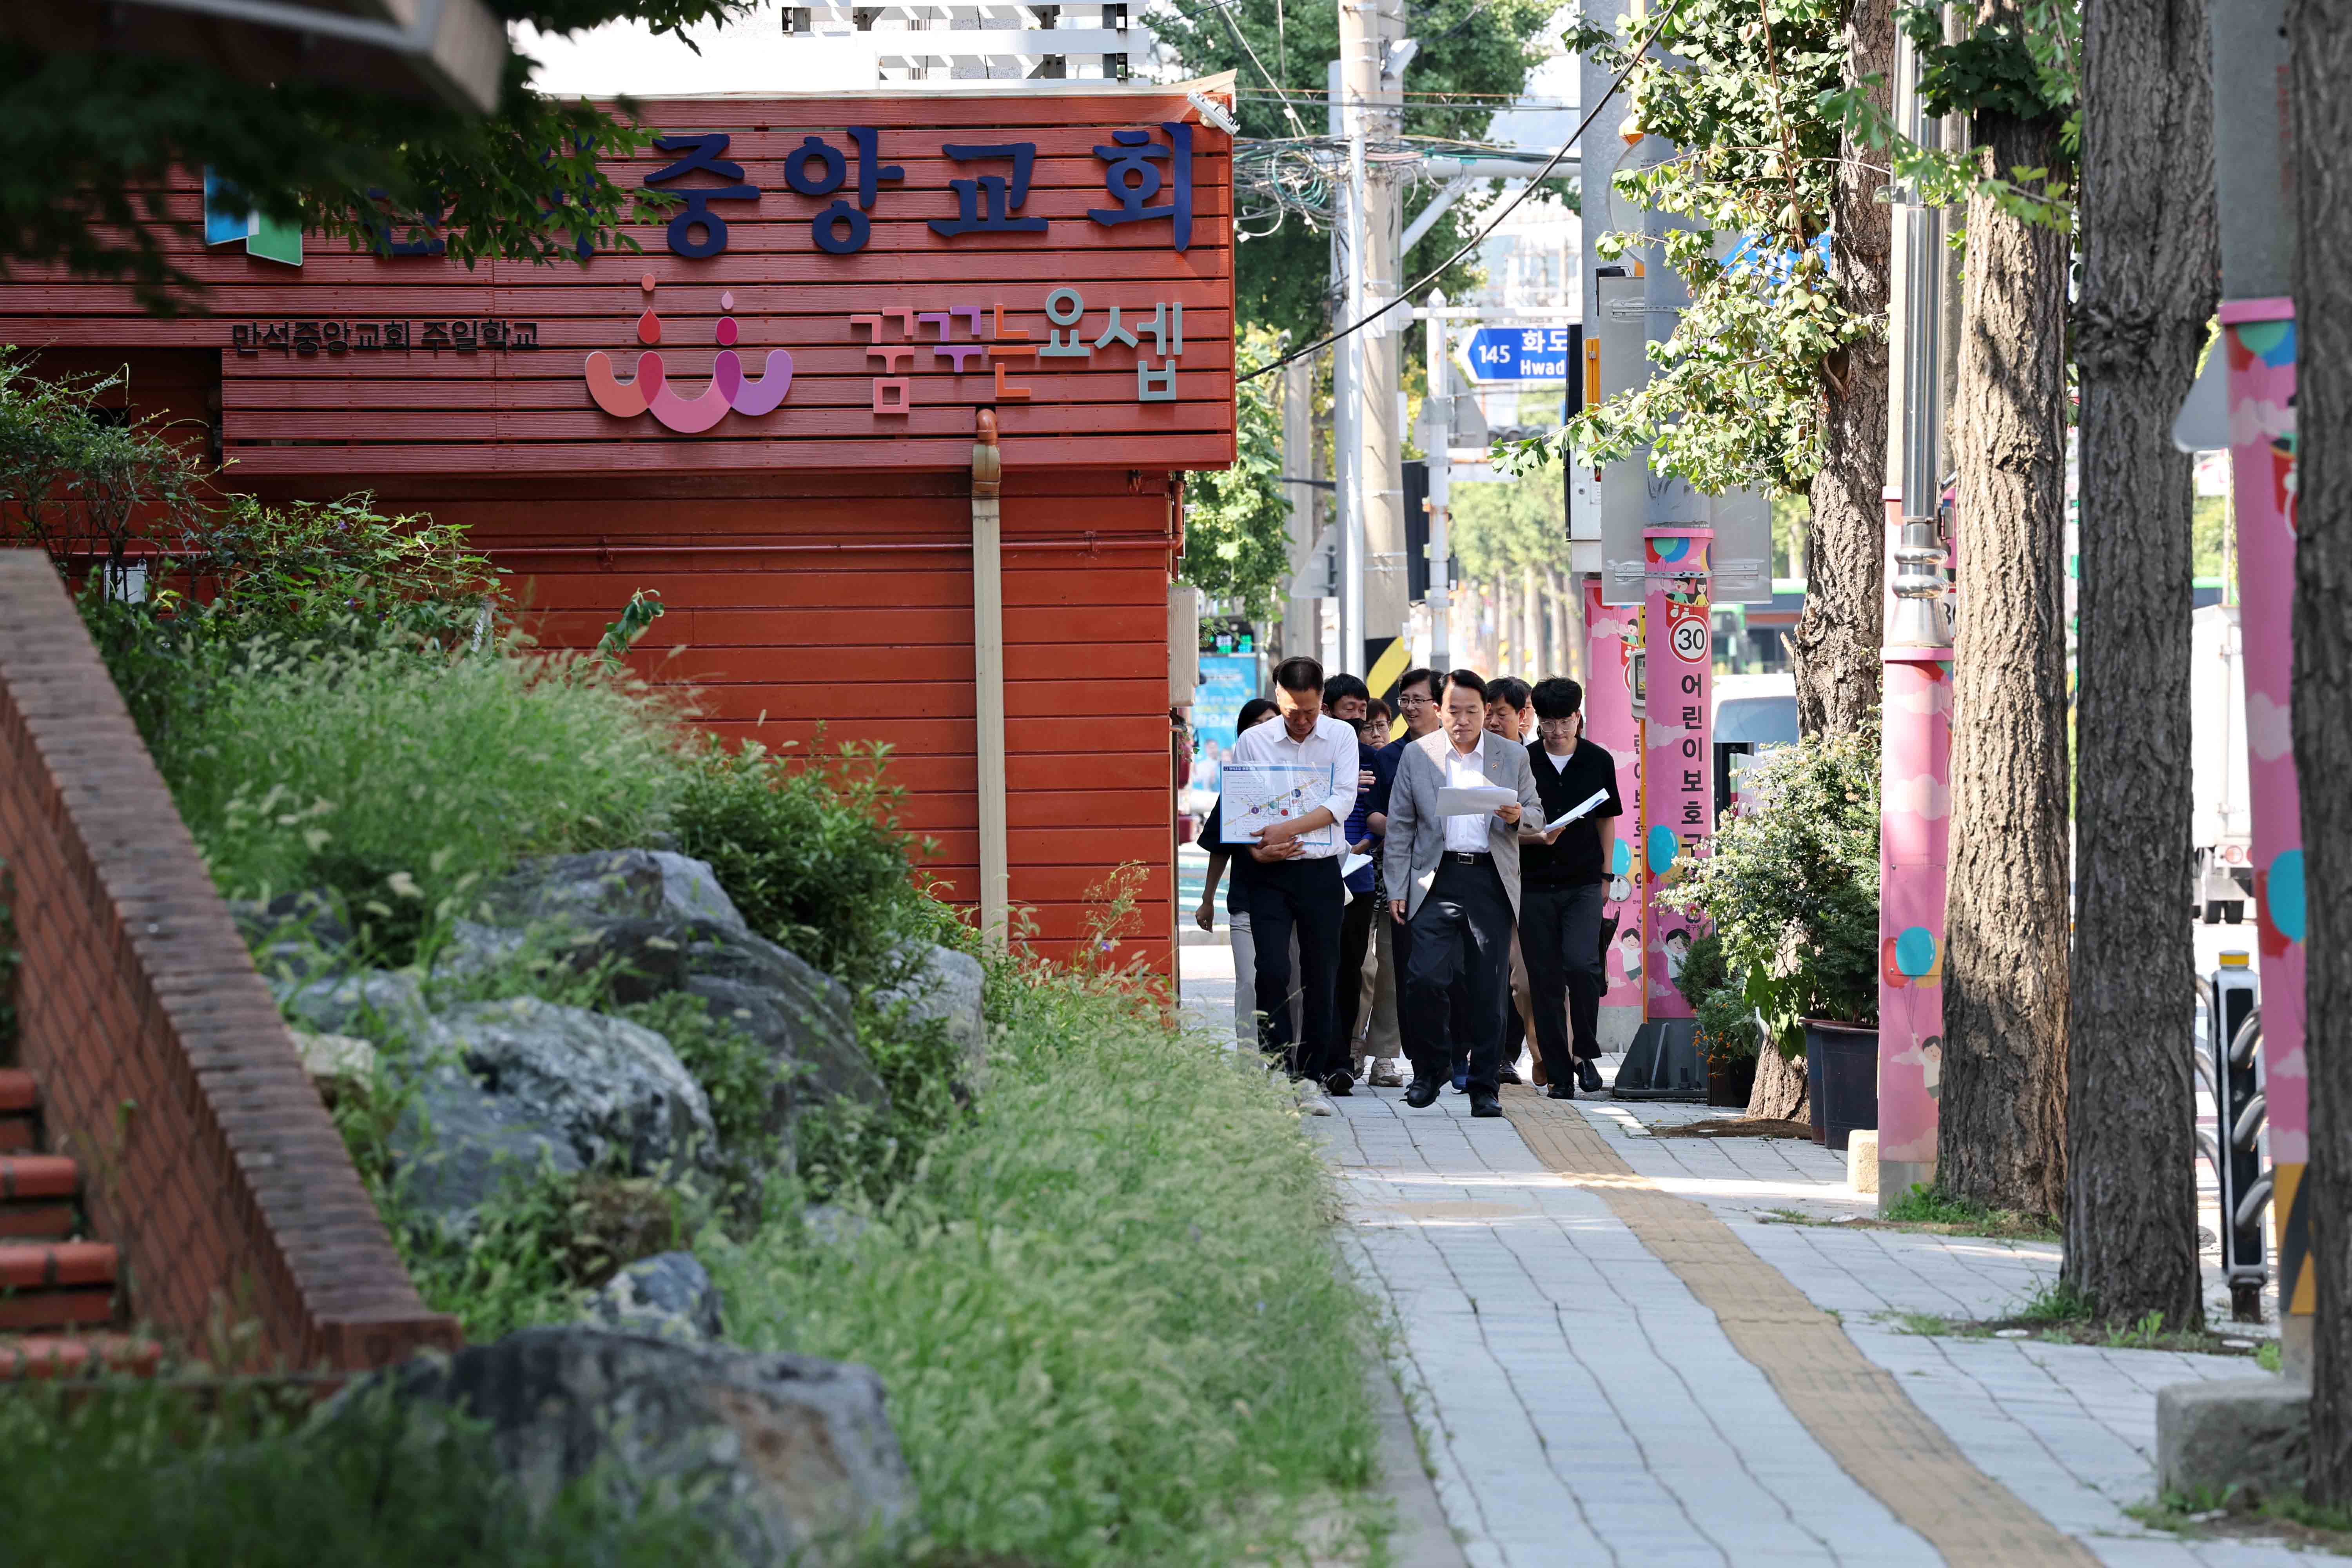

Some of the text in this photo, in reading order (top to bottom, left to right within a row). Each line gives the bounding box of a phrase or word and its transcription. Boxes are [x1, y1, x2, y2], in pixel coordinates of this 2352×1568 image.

[363, 121, 1192, 259] 중앙교회
[232, 318, 540, 357] 만석중앙교회 주일학교
[1479, 345, 1511, 363] 145
[1678, 628, 1705, 651] 30
